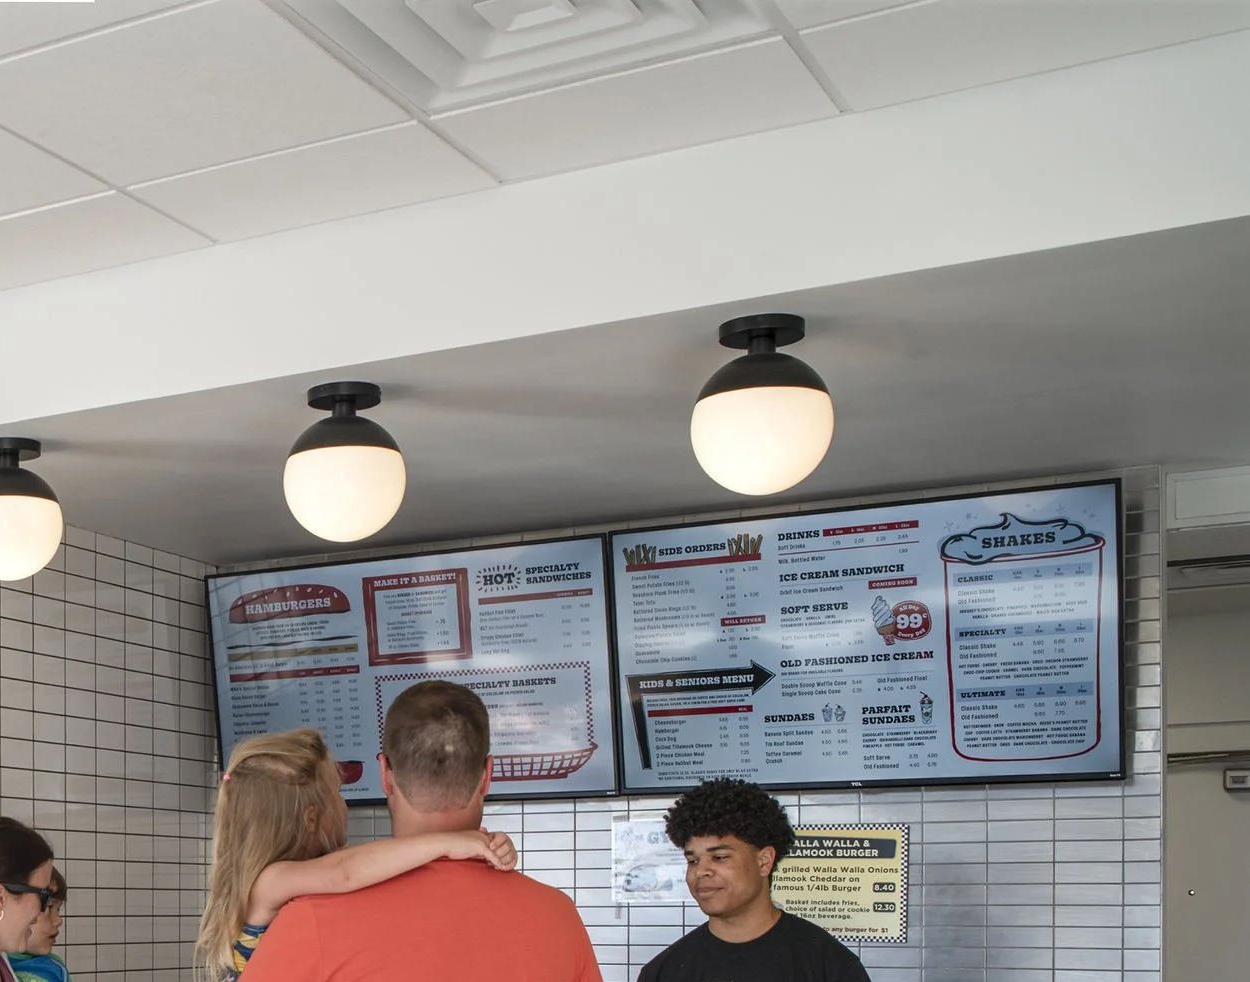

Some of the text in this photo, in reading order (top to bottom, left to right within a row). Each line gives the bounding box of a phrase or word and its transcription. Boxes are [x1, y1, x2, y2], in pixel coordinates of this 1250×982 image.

[777, 530, 820, 541] DRINKS
[981, 531, 1056, 549] SHAKES
[658, 543, 726, 556] SIDE ORDERS
[525, 563, 580, 574] SPECIALTY
[779, 564, 904, 582] ICE CREAM SANDWICH
[373, 578, 398, 587] MAKE
[419, 573, 456, 583] BASKET!
[482, 572, 515, 586] HOT
[525, 571, 591, 584] SANDWICHES
[957, 574, 994, 583] CLASSIC
[245, 597, 331, 614] HAMBURGERS
[780, 603, 848, 614] SOFT SERVE
[959, 628, 1006, 637] SPECIALTY
[780, 651, 934, 667] OLD FASHIONED ICE CREAM
[465, 677, 556, 690] PECIALTY BASKETS
[639, 675, 754, 688] KIDS & SENIORS MENU
[861, 705, 911, 714] PARFAIT
[764, 713, 814, 722] SUNDAES
[862, 715, 915, 724] SUNDAES
[822, 840, 860, 848] WALLA
[863, 840, 870, 848] &
[786, 849, 878, 857] LAMOOK BURGER
[782, 866, 810, 875] grilled
[806, 884, 829, 892] 1/4lb
